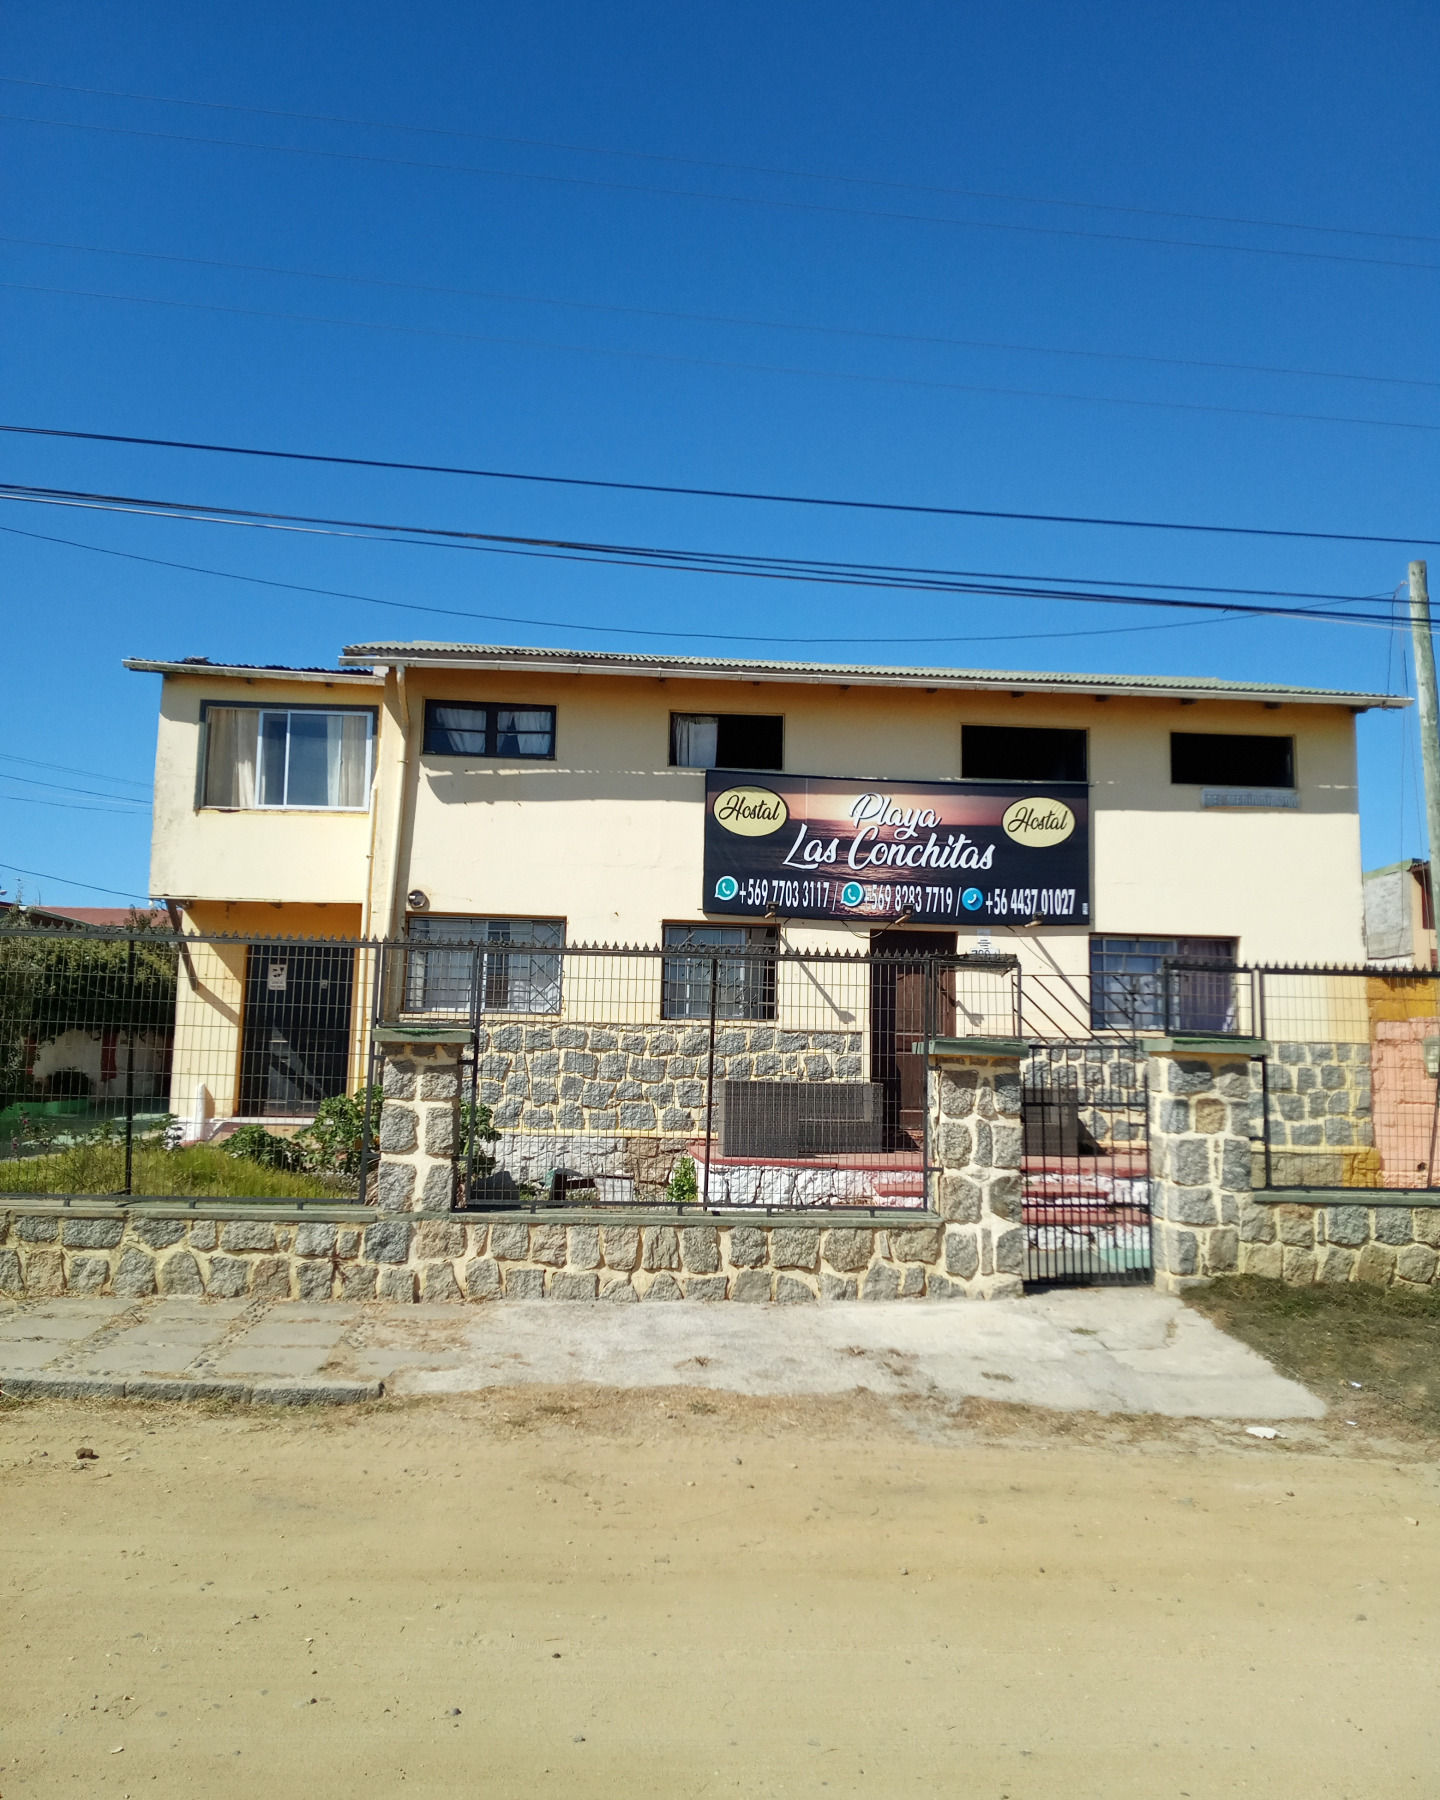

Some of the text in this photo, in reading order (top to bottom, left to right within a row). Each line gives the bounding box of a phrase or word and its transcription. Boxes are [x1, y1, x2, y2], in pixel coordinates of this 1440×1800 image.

[719, 795, 781, 821] Hostal
[849, 793, 942, 840] Playa
[1007, 806, 1069, 833] Hostal
[782, 822, 996, 870] Las Conchitas
[739, 878, 768, 906] +569
[772, 879, 799, 908] 7703
[803, 881, 830, 908] 3117
[864, 884, 892, 911] +569
[925, 886, 953, 914] 7719
[985, 888, 1008, 915] +56
[1010, 888, 1038, 915] 4437
[1040, 888, 1076, 916] 01027
